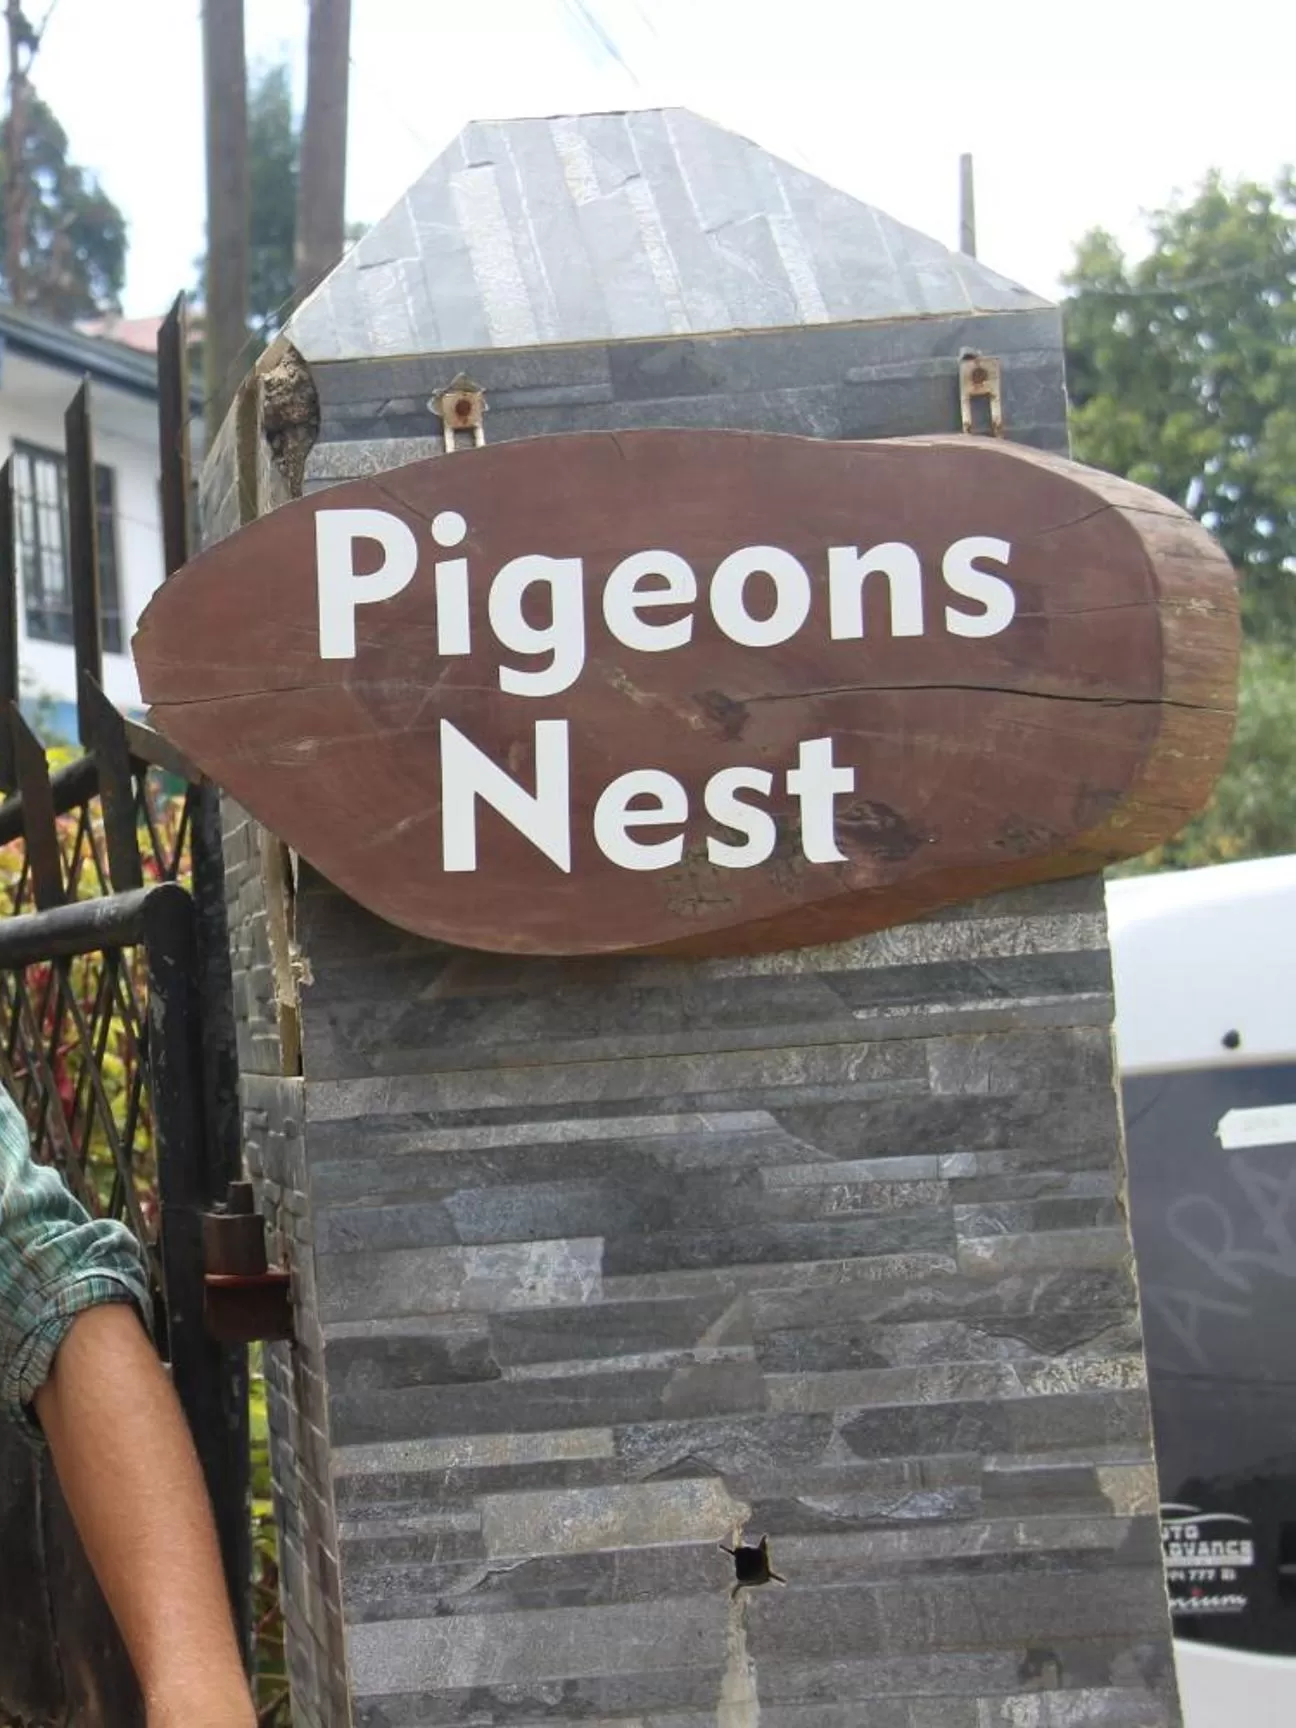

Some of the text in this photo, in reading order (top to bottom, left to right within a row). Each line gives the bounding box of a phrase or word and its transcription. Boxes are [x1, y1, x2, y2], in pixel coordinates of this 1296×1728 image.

[315, 509, 1015, 697] Pigeons
[440, 718, 854, 873] Nest
[1161, 1525, 1199, 1540] UTO
[1164, 1540, 1253, 1557] DVANCE
